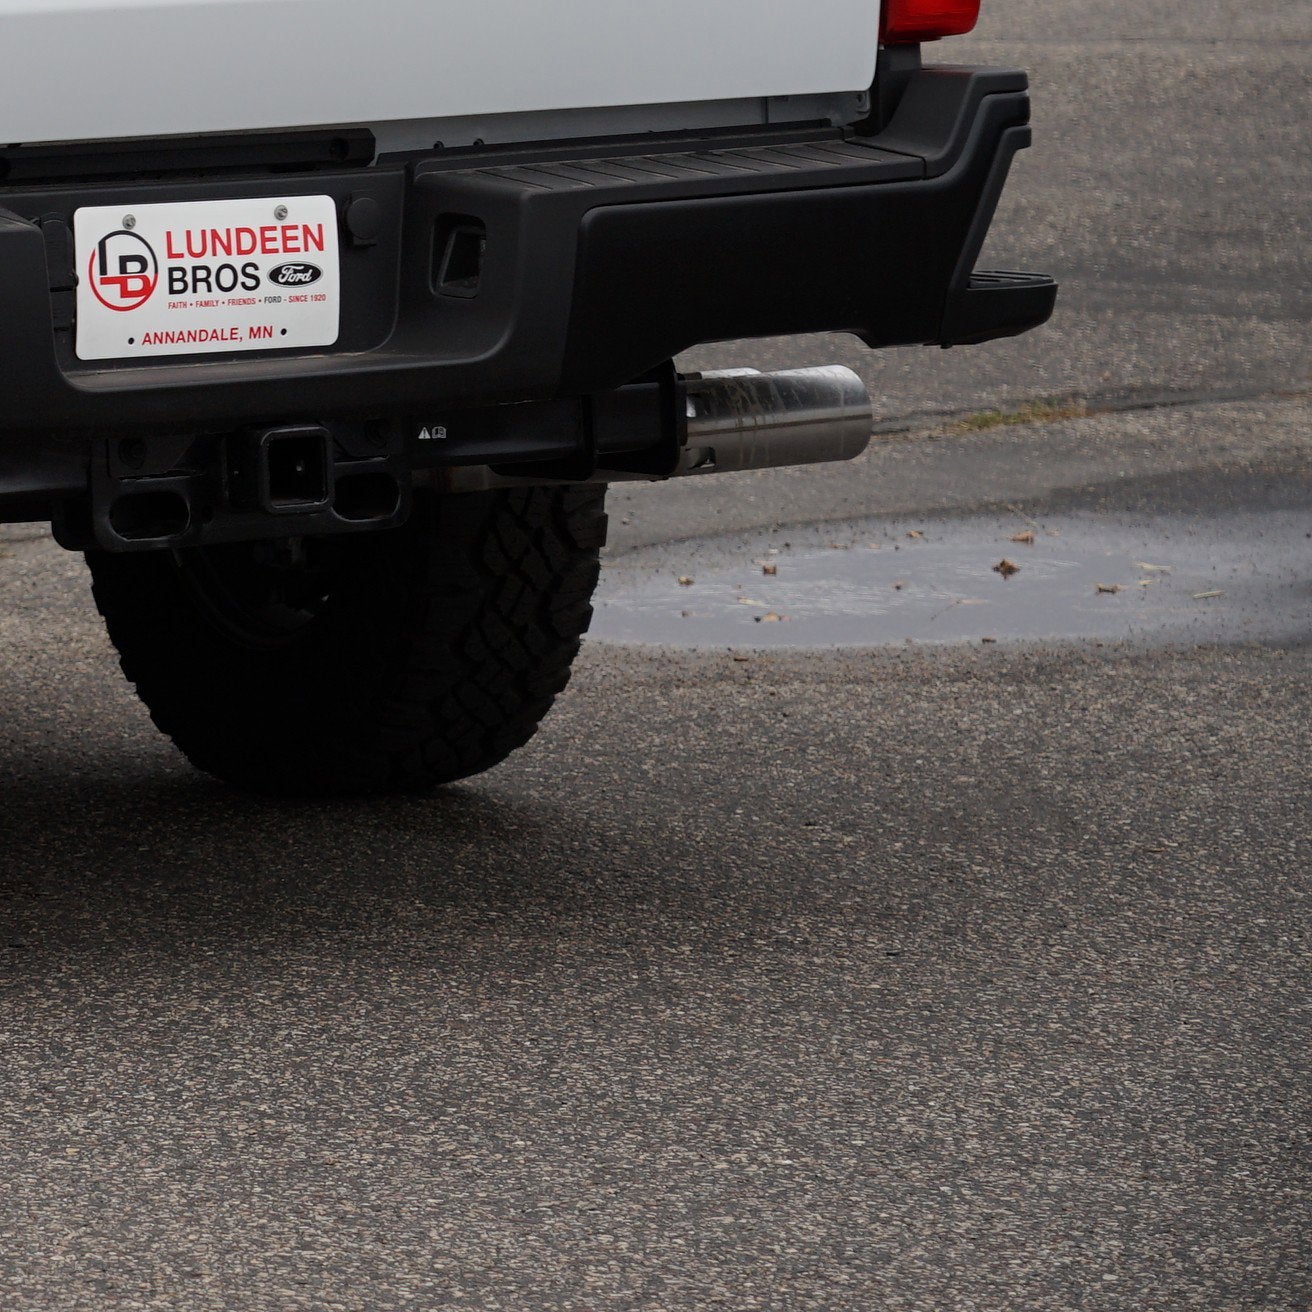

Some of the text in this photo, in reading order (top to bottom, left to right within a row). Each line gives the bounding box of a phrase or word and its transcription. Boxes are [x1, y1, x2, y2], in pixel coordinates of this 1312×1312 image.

[166, 223, 324, 259] LUNDEEN
[168, 262, 313, 295] BROS Ford
[168, 293, 327, 309] FAITH FAMILY FRIENDS FORD SINCE 1920
[142, 325, 274, 346] ANNANDALE, MN
